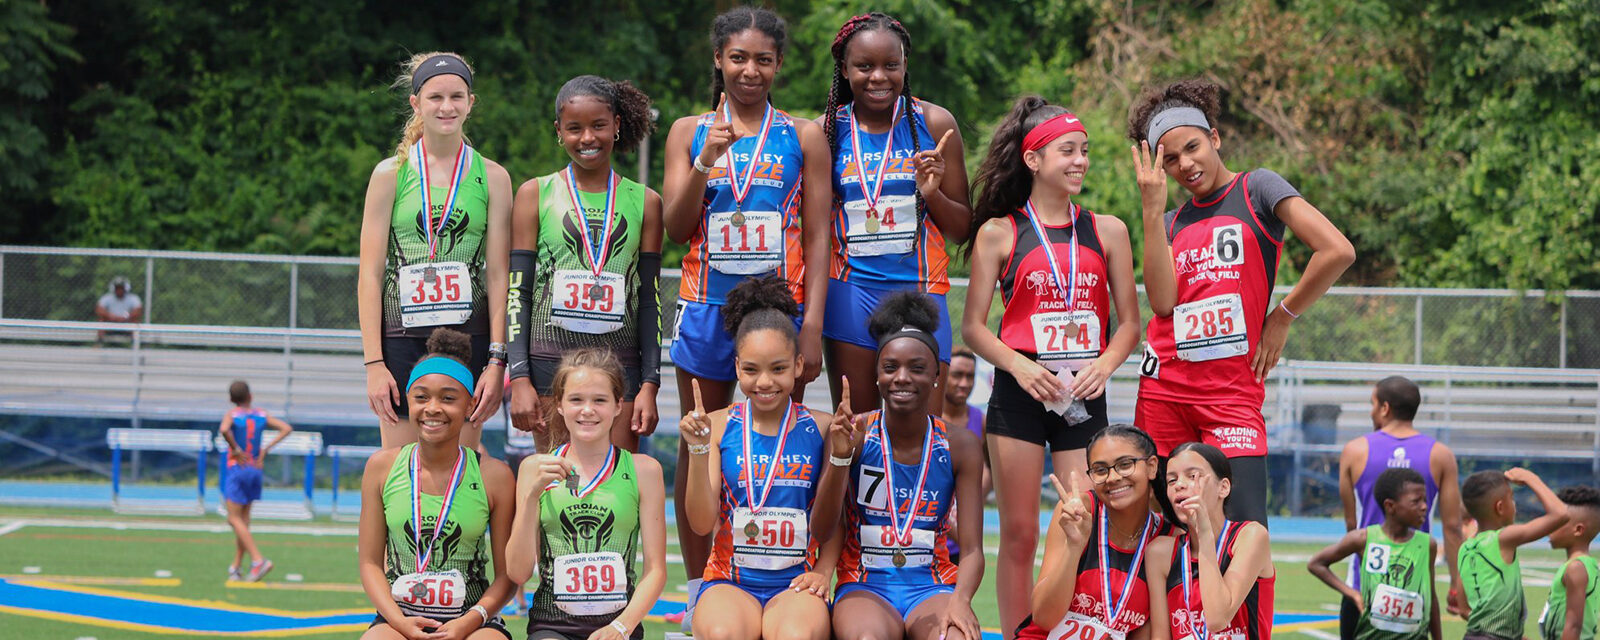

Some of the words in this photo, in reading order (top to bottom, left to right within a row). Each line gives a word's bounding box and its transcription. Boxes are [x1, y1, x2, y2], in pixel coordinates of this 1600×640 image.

[755, 179, 783, 188] CLUB
[720, 224, 768, 252] 111
[1216, 228, 1239, 263] 6
[589, 275, 617, 283] OLYMPIC
[1218, 270, 1240, 280] FIELD
[411, 274, 461, 304] 335
[564, 283, 614, 313] 359
[404, 305, 433, 313] ASSOCIATION
[434, 303, 470, 311] CHAMPIONSHIPS
[1040, 301, 1065, 310] TRACK
[554, 310, 585, 318] ASSOCIATION
[585, 313, 622, 321] CHAMPIONSHIPS
[1185, 307, 1234, 340] 285
[1043, 323, 1091, 351] 274
[1178, 340, 1208, 349] ASSOCIATION
[1208, 335, 1245, 345] CHAMPIONSHIPS
[863, 468, 885, 504] 7
[566, 502, 609, 513] TROJAN
[590, 510, 606, 518] CLUB
[769, 511, 797, 519] OLYMPIC
[563, 557, 587, 566] JUNIOR
[1369, 547, 1385, 571] 3
[565, 564, 615, 593] 369
[403, 579, 454, 606] 356
[1379, 595, 1414, 618] 354
